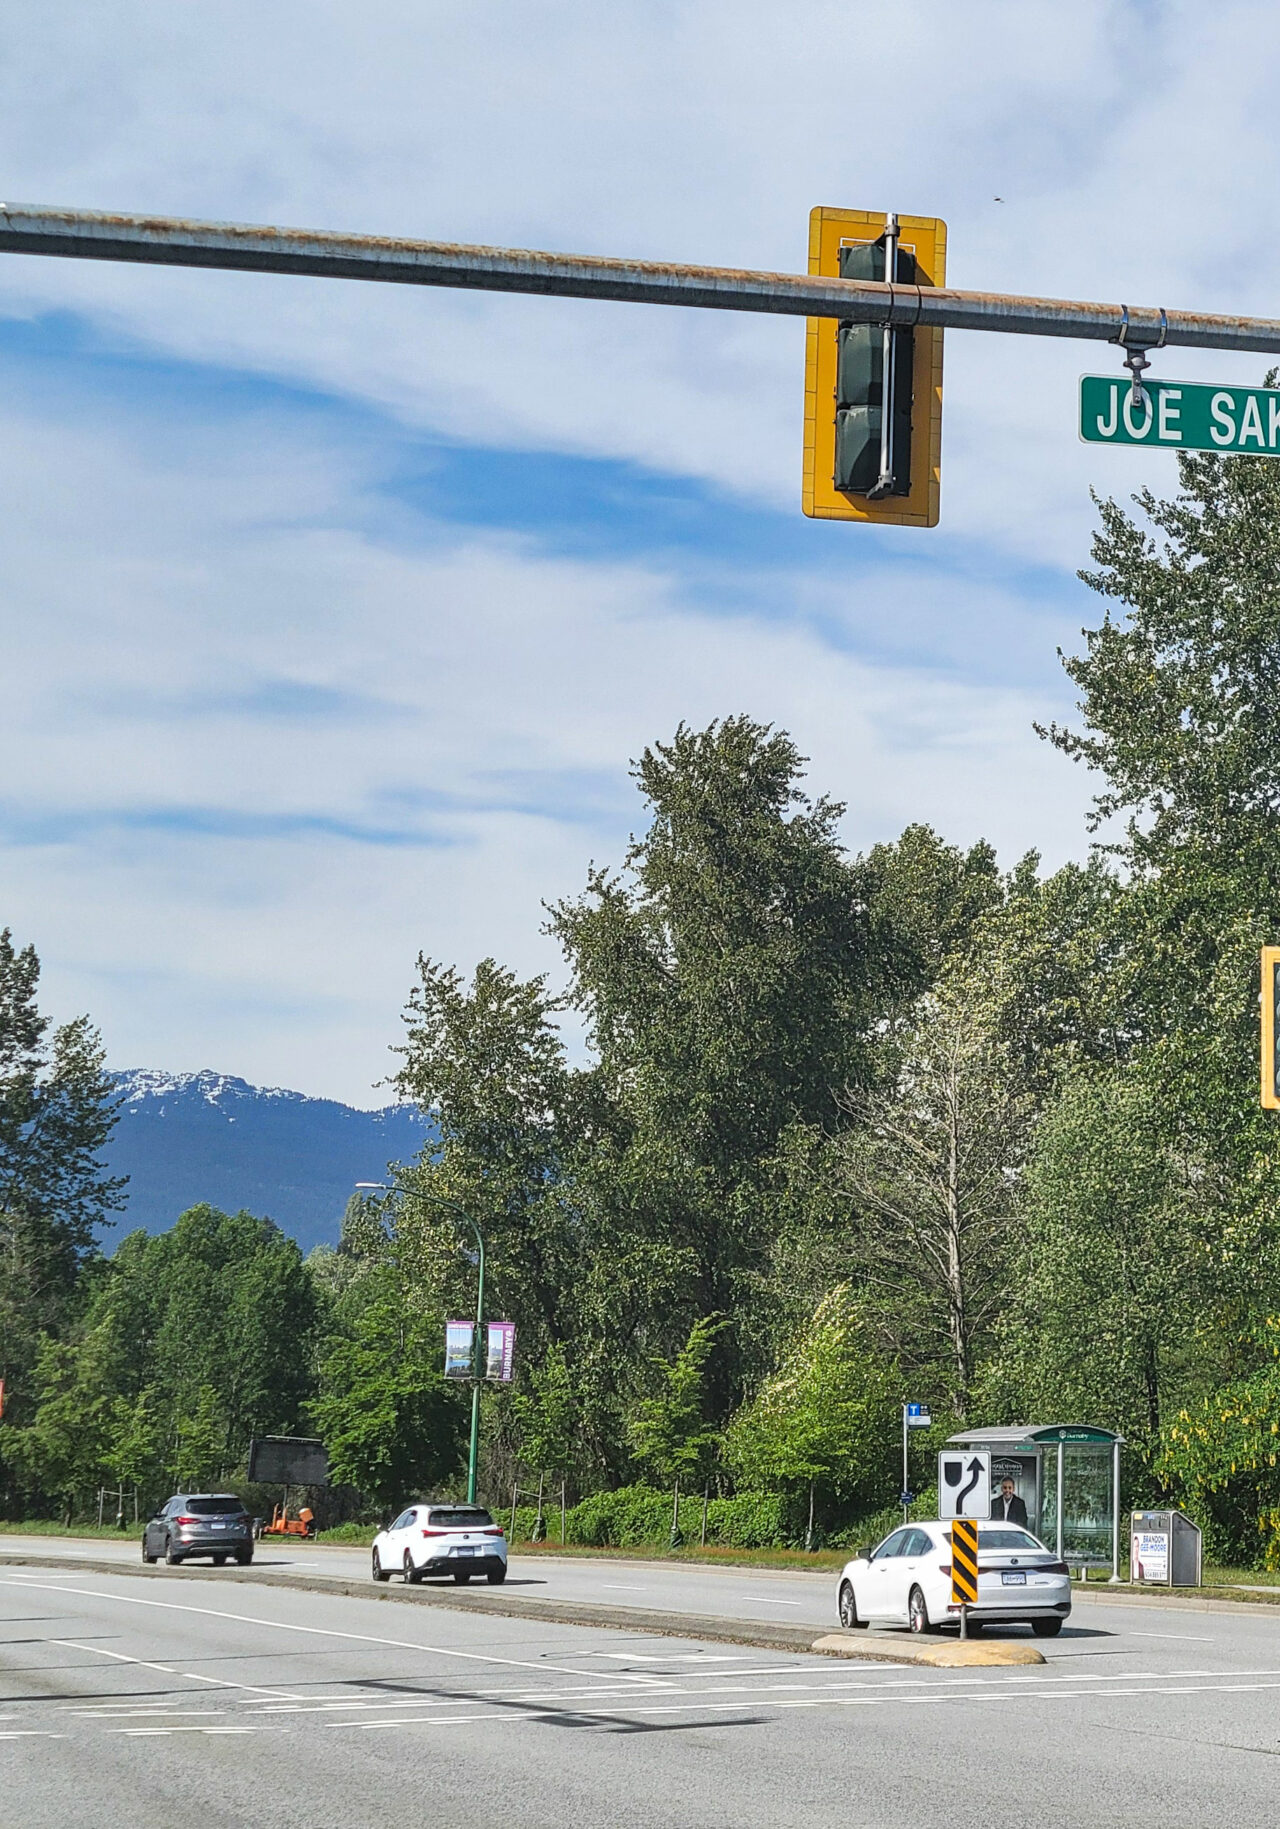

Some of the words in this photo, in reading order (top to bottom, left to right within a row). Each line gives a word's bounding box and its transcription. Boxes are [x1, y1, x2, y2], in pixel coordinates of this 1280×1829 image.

[1096, 384, 1183, 441] JOE
[502, 1336, 513, 1379] BURNABY
[1143, 1535, 1164, 1543] BRANDON
